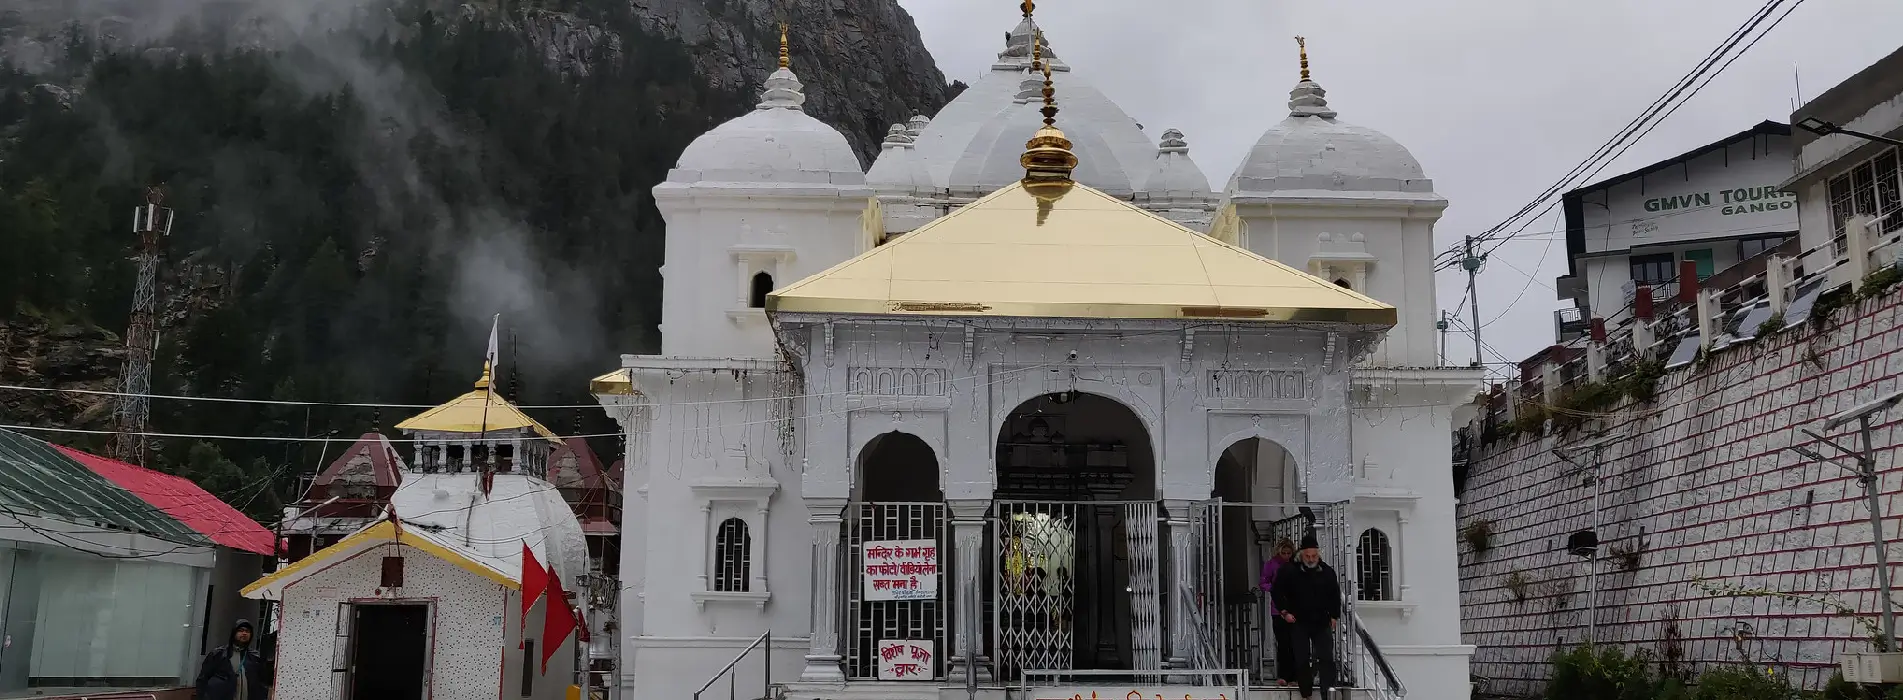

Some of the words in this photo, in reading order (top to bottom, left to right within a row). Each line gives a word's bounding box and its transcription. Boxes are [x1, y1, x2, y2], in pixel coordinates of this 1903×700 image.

[1644, 192, 1710, 212] GMVN
[1719, 186, 1796, 204] TOURI
[1721, 200, 1797, 215] GANGO
[866, 546, 893, 560] मन्दिर
[895, 546, 903, 558] के
[922, 546, 935, 561] गृह
[866, 564, 877, 576] का
[892, 579, 908, 589] मना
[881, 643, 905, 662] विशेष
[910, 645, 931, 664] पूजा
[894, 664, 918, 677] द्वार
